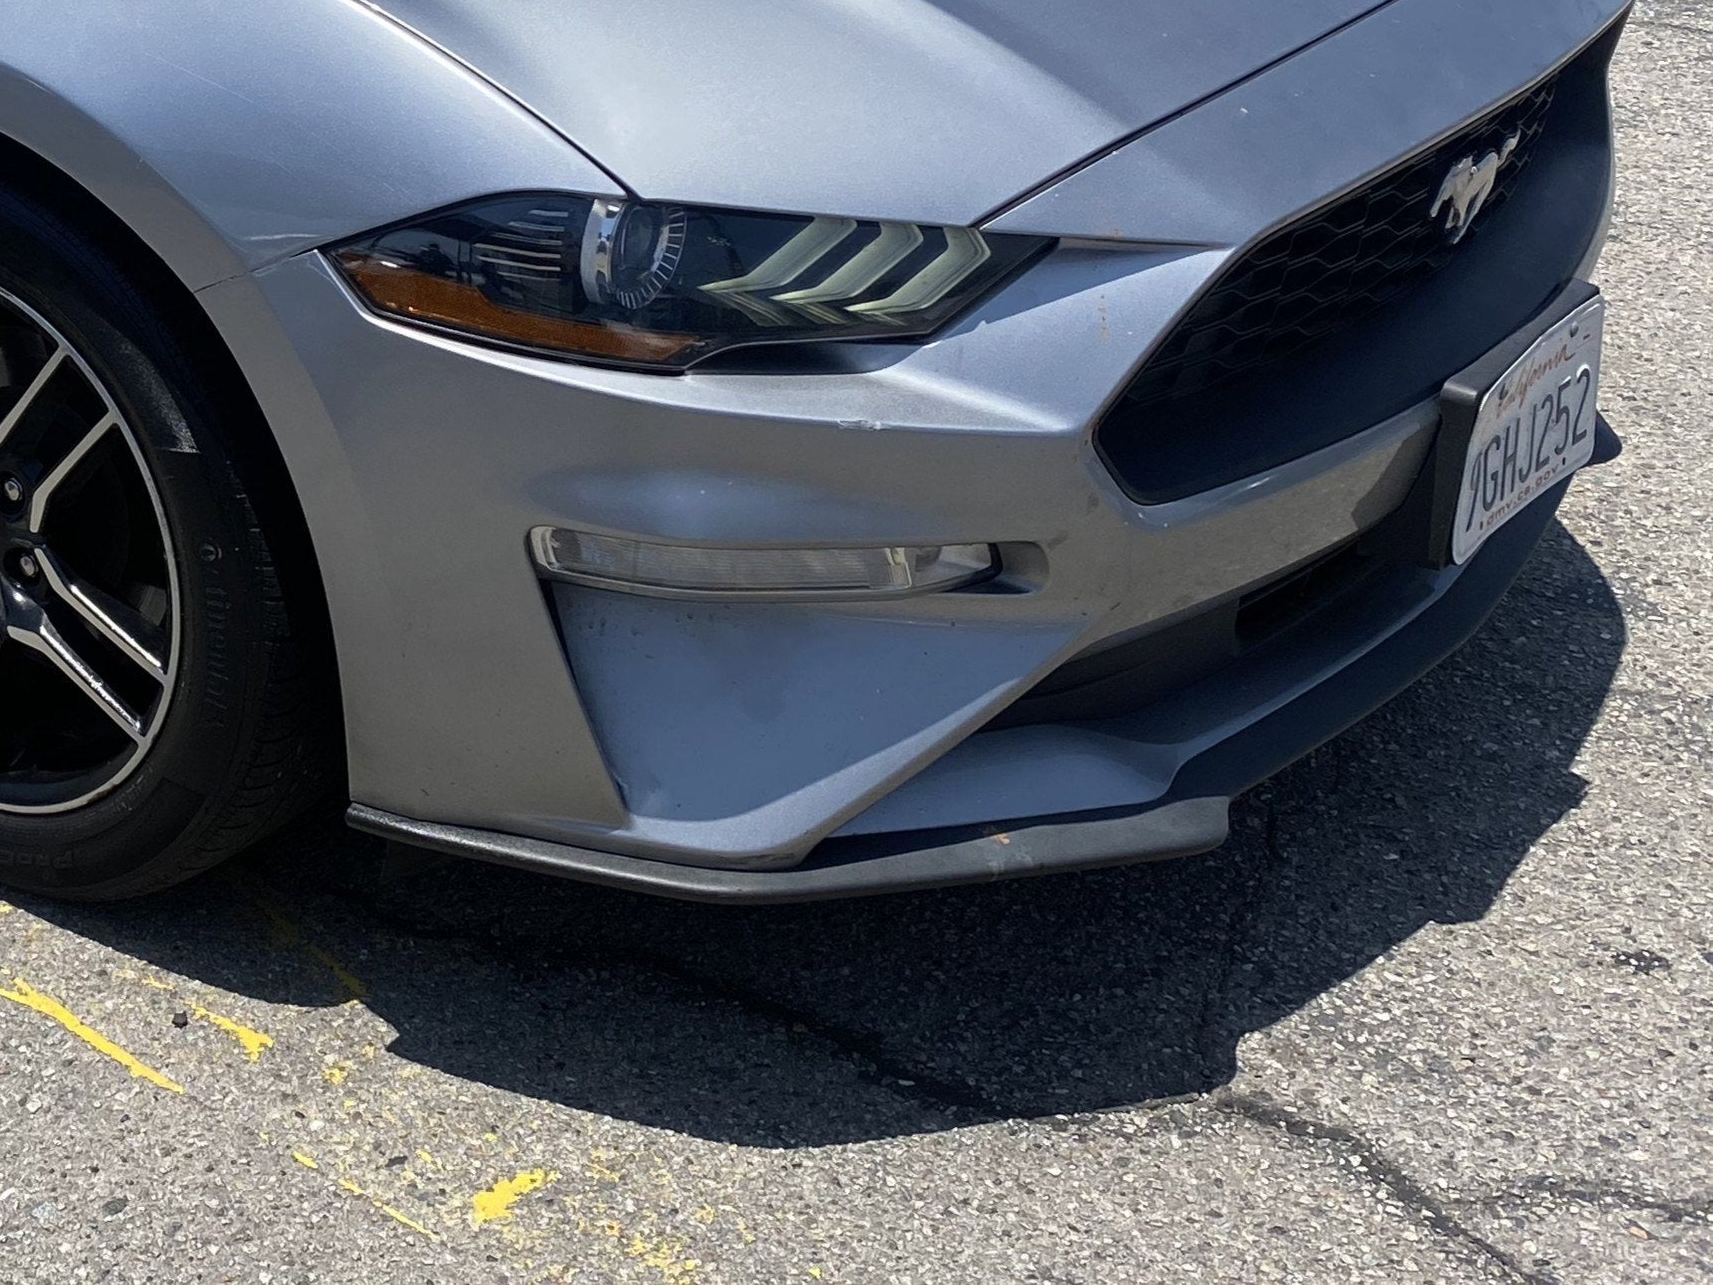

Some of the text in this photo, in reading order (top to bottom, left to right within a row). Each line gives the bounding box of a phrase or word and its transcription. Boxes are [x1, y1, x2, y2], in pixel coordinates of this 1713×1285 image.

[1496, 344, 1576, 418] California
[1466, 367, 1590, 533] 9GHJ252
[1486, 463, 1560, 527] dmv.ca.gov
